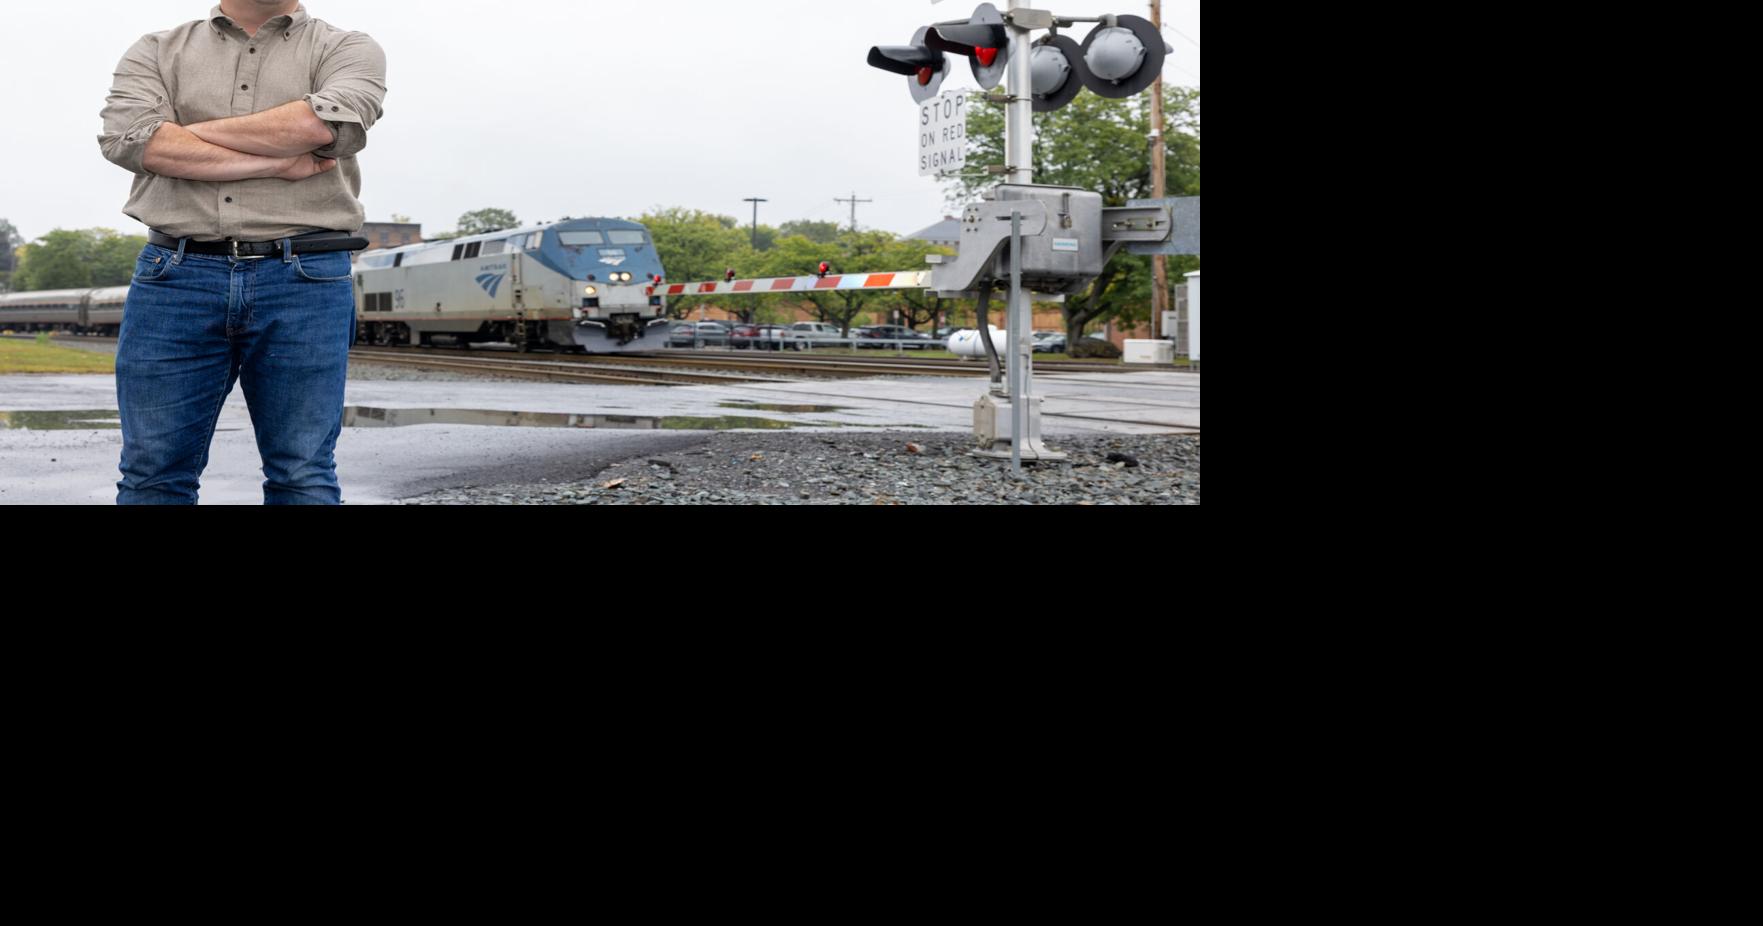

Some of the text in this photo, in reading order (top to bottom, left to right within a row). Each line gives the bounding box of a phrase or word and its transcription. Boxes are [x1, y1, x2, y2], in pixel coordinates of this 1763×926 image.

[922, 95, 963, 125] STOP
[921, 123, 963, 148] ON RED
[921, 147, 963, 170] SIGNAL
